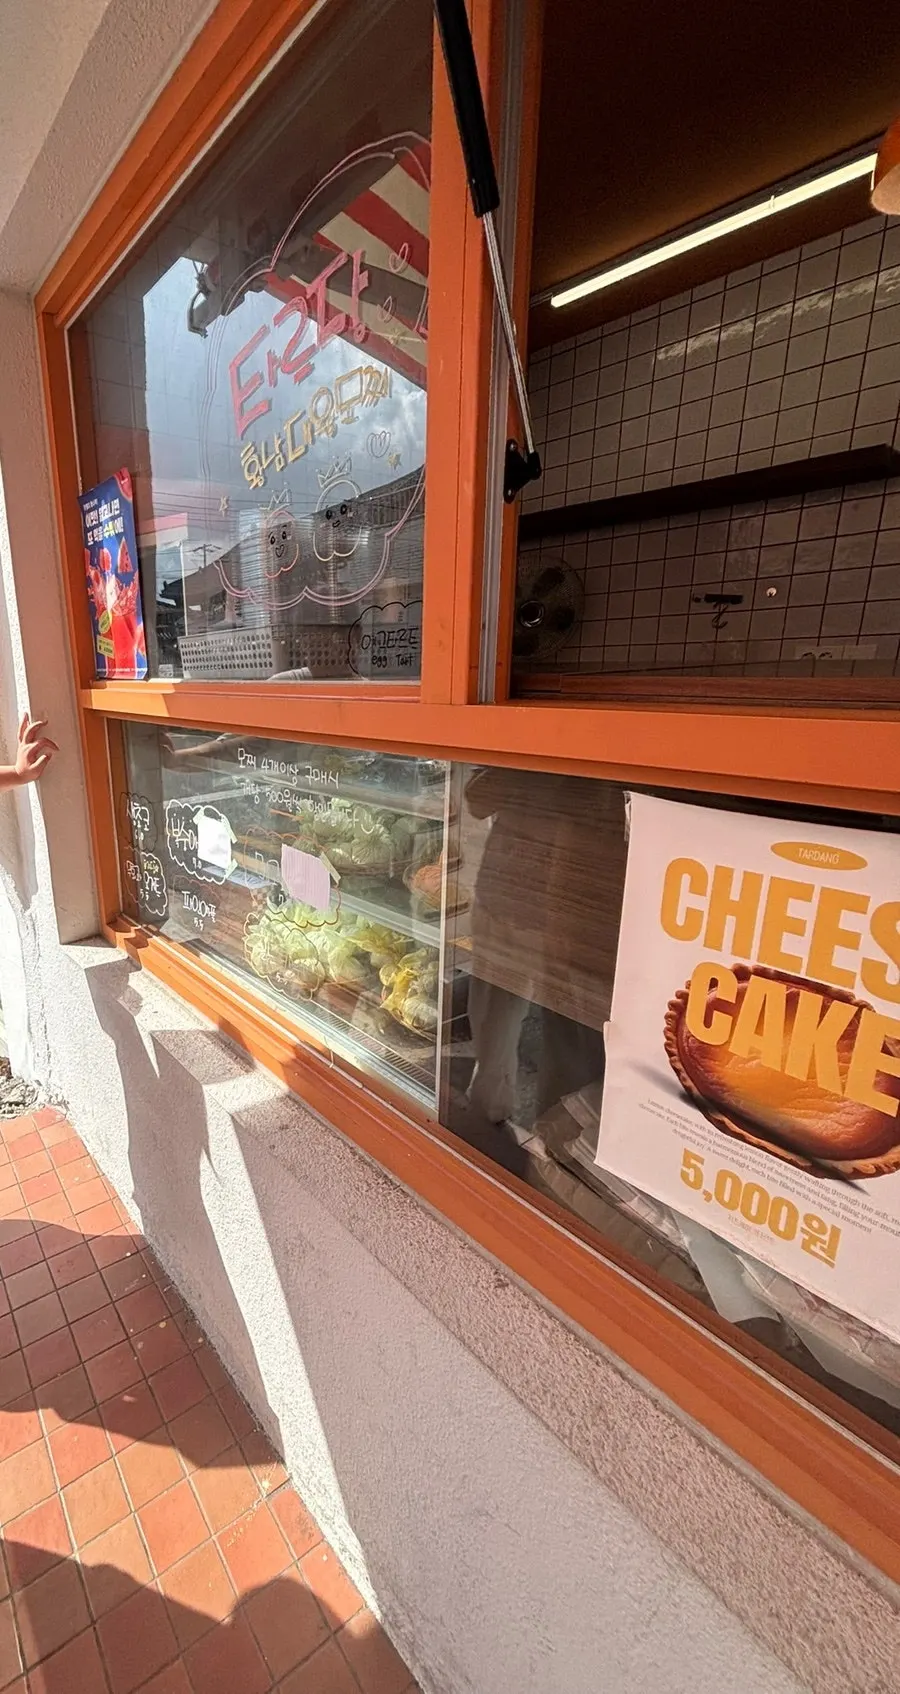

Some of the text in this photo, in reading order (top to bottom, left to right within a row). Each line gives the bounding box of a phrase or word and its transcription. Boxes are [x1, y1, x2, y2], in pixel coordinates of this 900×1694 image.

[371, 655, 387, 668] egg
[798, 847, 840, 865] TARDANG
[685, 962, 900, 1117] CAKE
[680, 1148, 841, 1269] 5,000원
